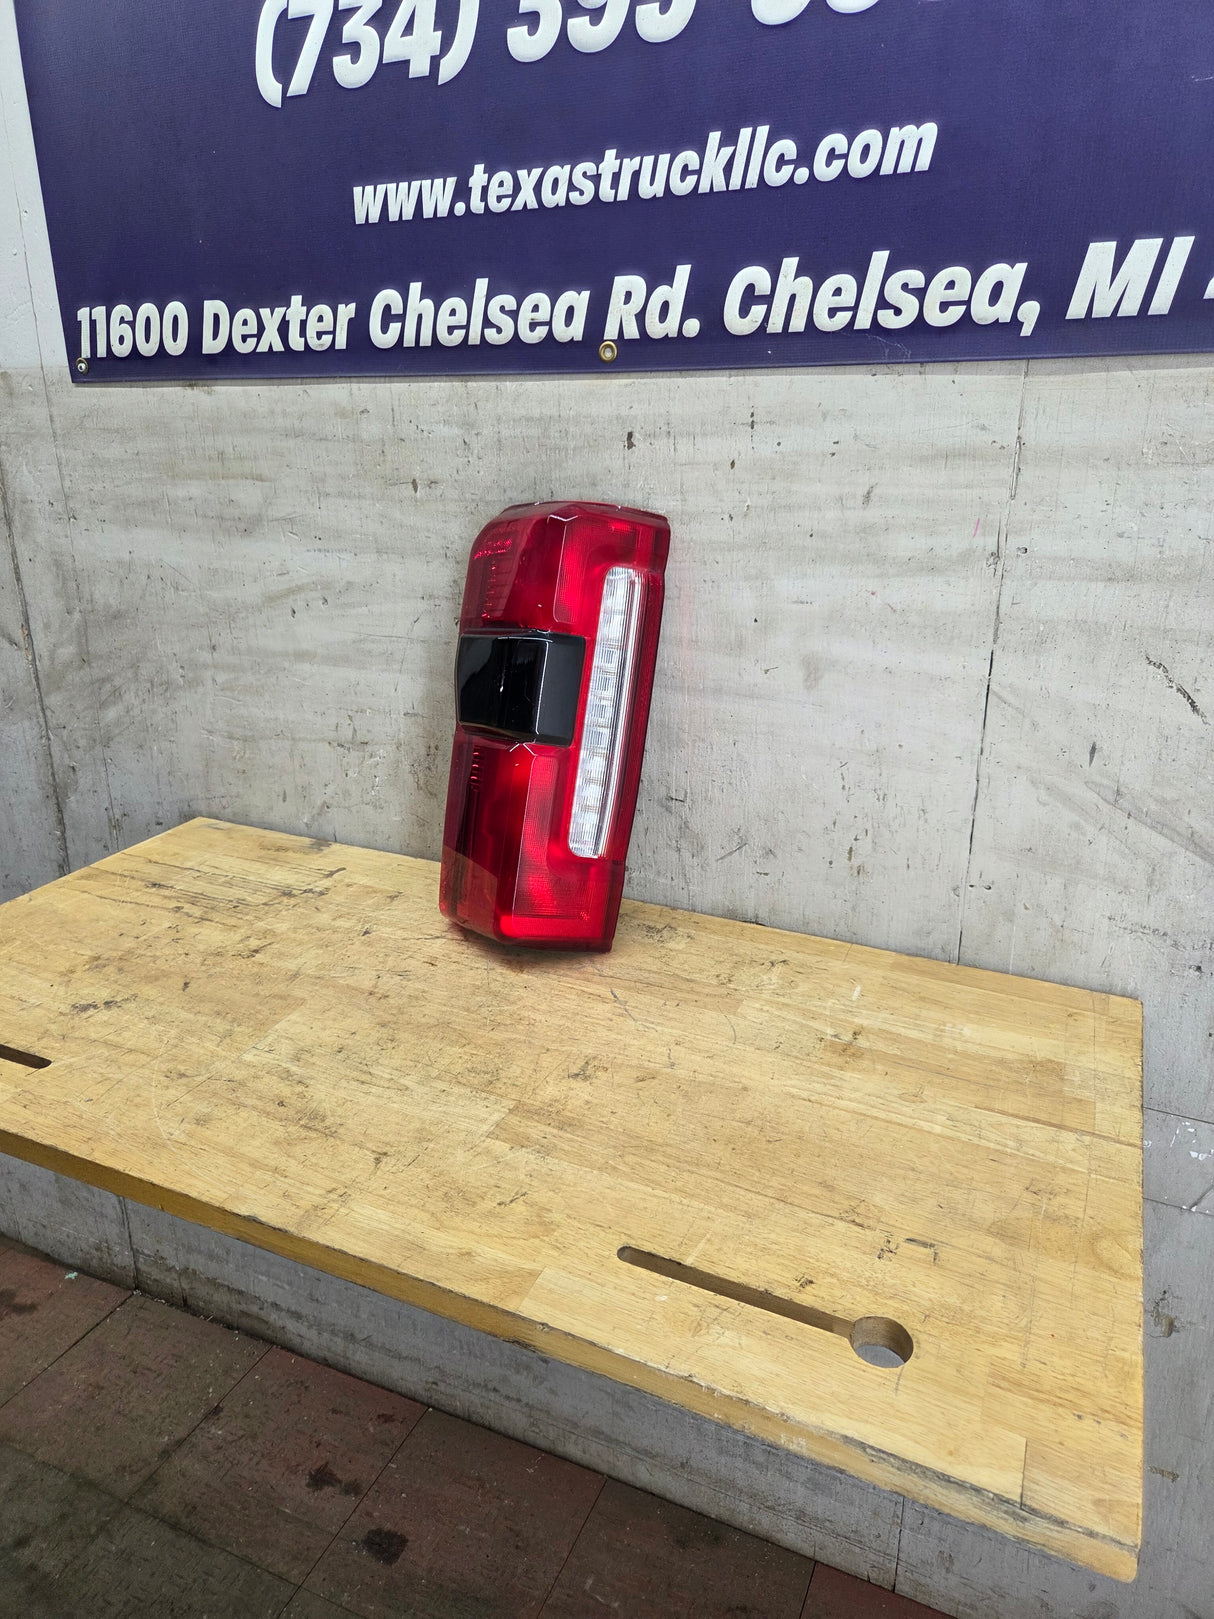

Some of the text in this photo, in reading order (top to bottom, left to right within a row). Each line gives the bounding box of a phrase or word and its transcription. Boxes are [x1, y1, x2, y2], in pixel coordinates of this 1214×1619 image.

[254, 0, 481, 108] (734)
[352, 121, 939, 225] www.texastruckllc.com
[77, 234, 1196, 359] 11600 Dexter Chelsea Rd. Chelsea, MI
